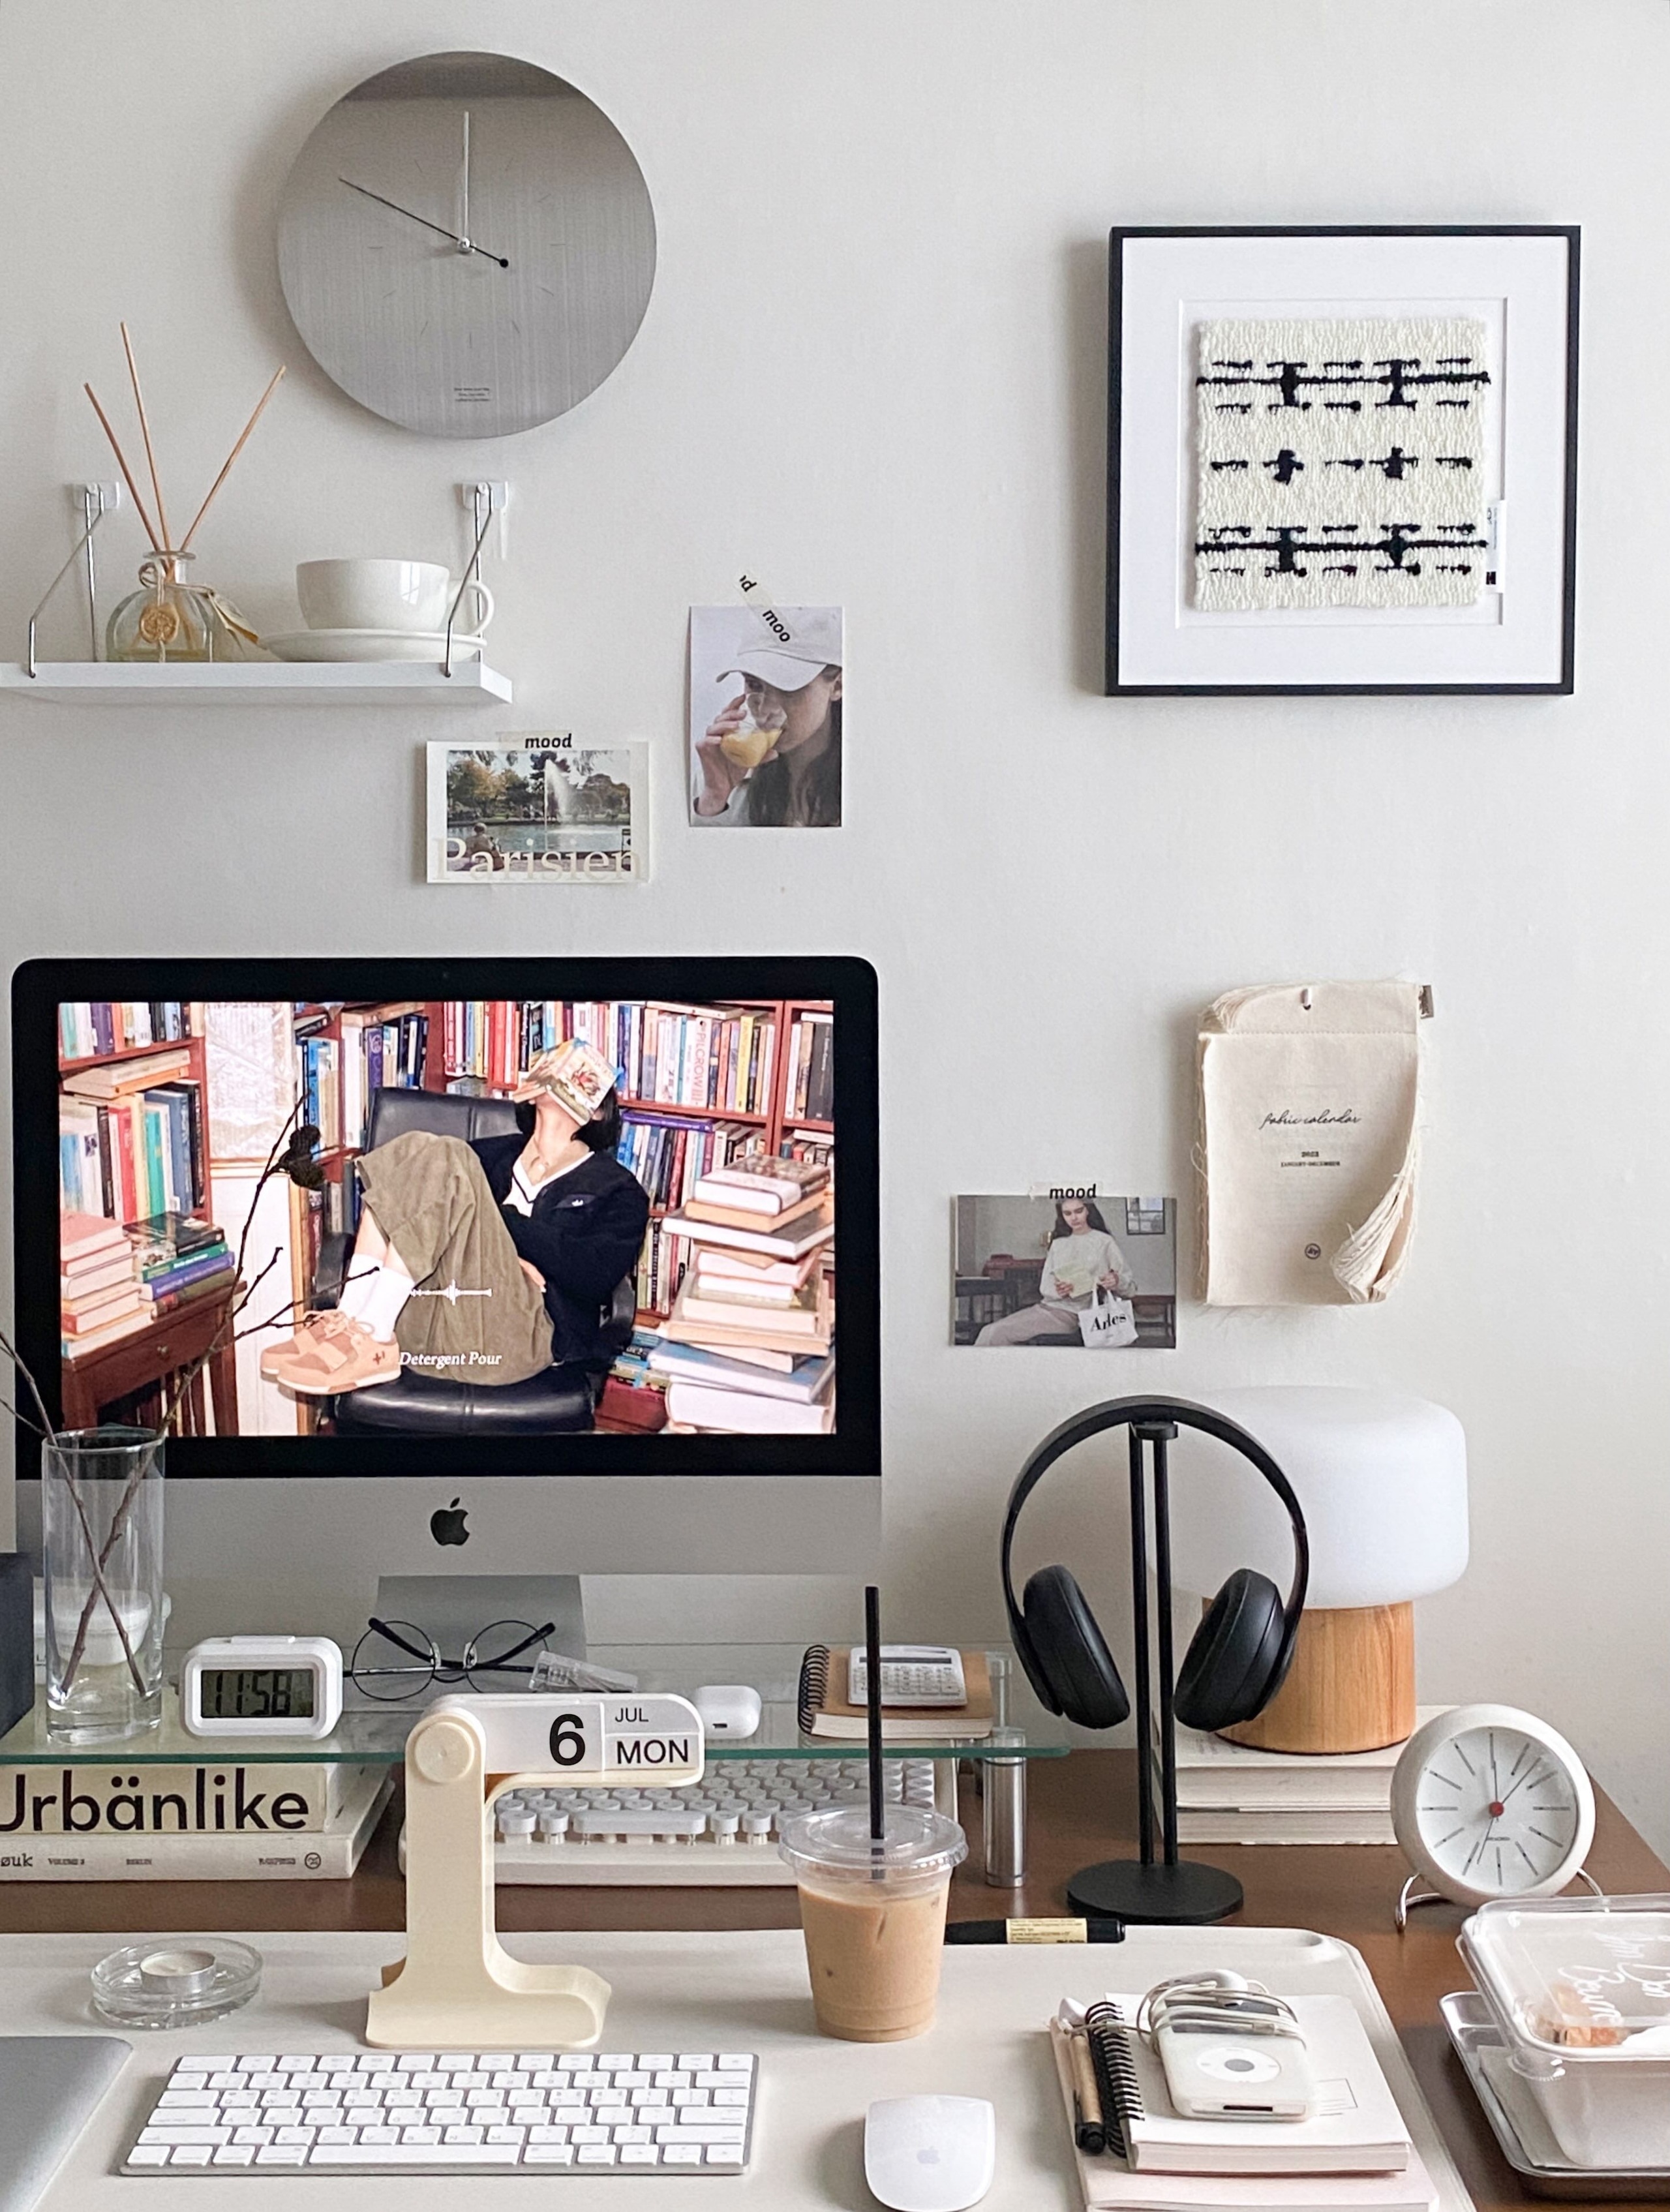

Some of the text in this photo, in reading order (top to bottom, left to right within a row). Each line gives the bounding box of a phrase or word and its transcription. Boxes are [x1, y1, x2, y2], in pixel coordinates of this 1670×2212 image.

[524, 733, 573, 749] mood
[433, 836, 643, 881] Parisien
[1303, 1108, 1361, 1125] calendar
[1049, 1183, 1097, 1200] mood
[399, 1351, 502, 1370] Detergent Pour
[215, 1671, 293, 1715] 11:58
[615, 1707, 649, 1723] JUL
[549, 1713, 586, 1766] 6
[616, 1738, 689, 1765] MON
